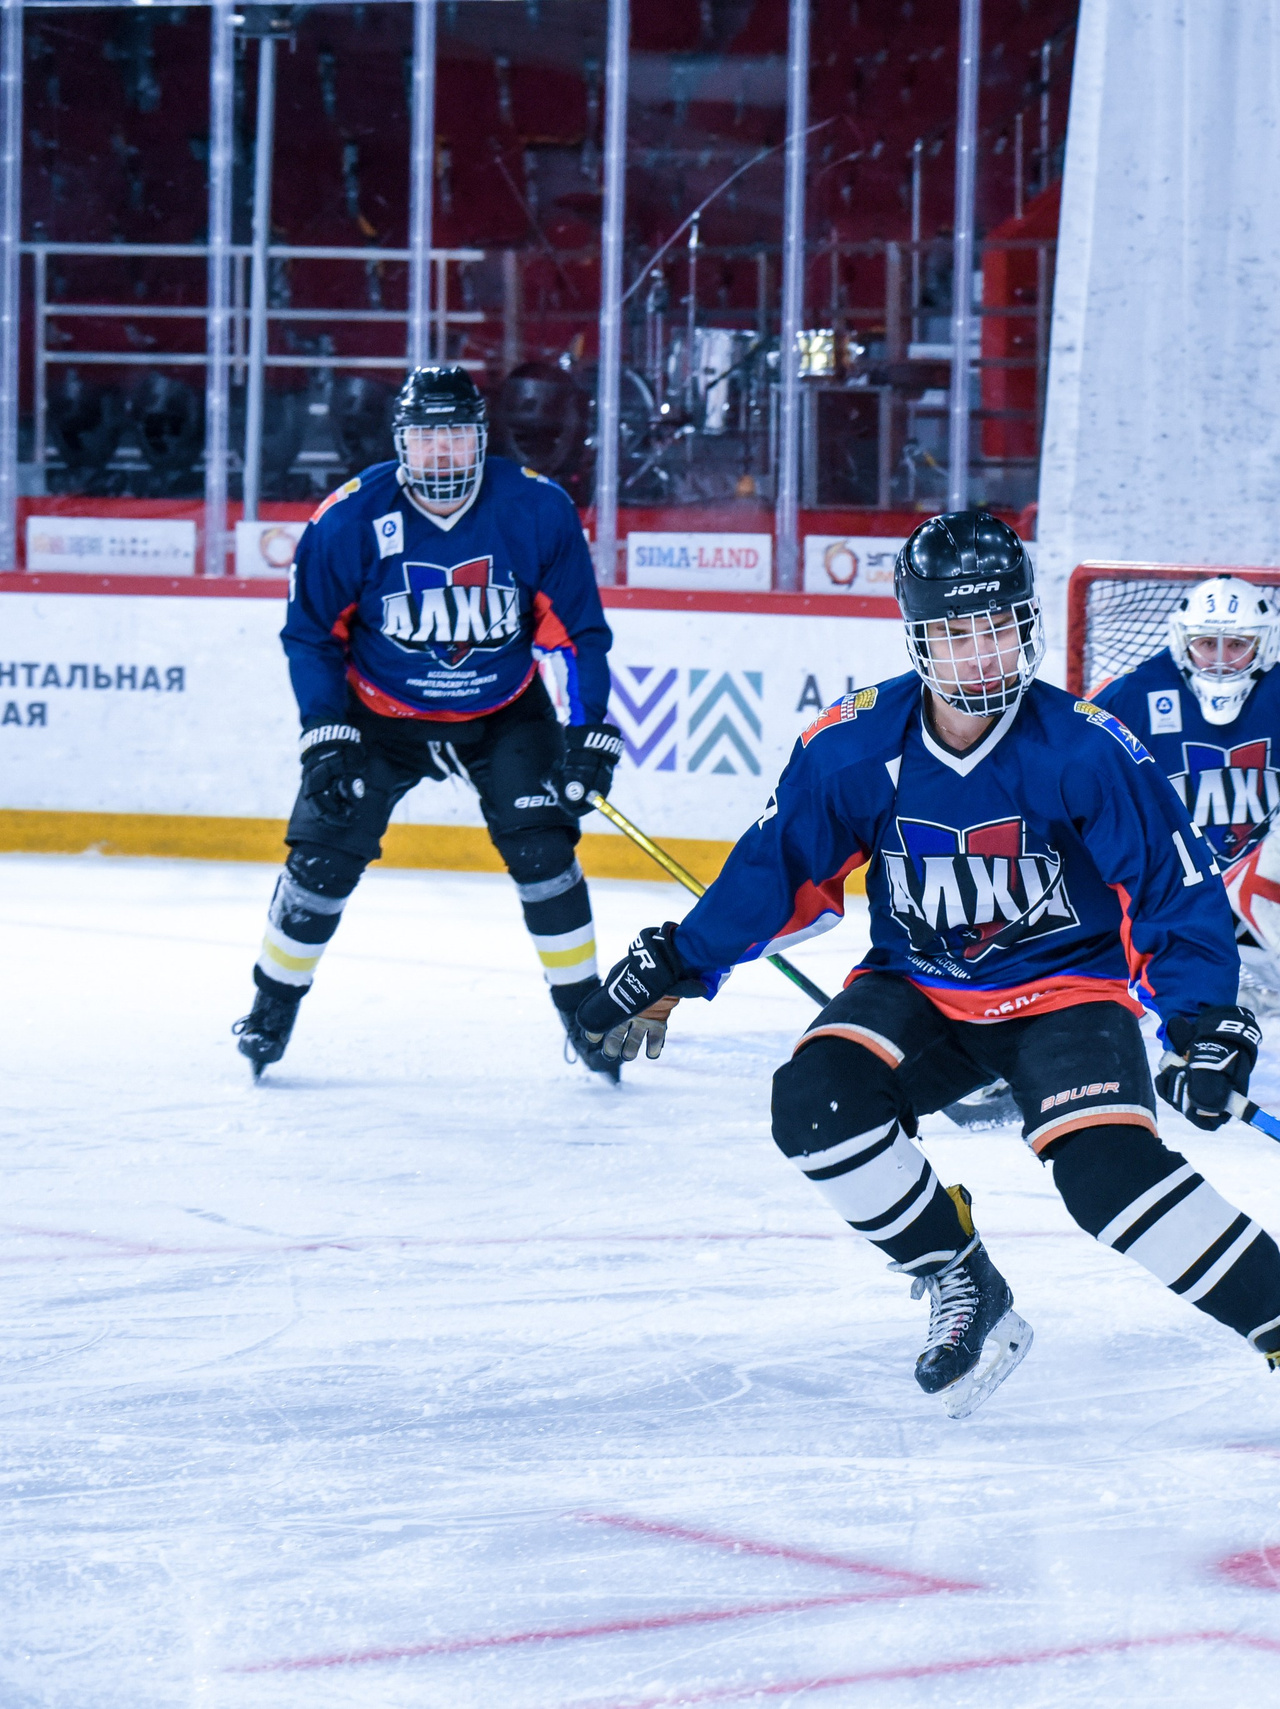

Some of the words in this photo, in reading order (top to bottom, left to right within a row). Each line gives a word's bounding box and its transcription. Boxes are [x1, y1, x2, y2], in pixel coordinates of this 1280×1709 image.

[635, 546, 759, 569] SIMA-LAND
[944, 580, 1001, 597] JOFA
[0, 662, 185, 692] НТАЛЬНАЯ
[1040, 1082, 1120, 1113] BAUER
